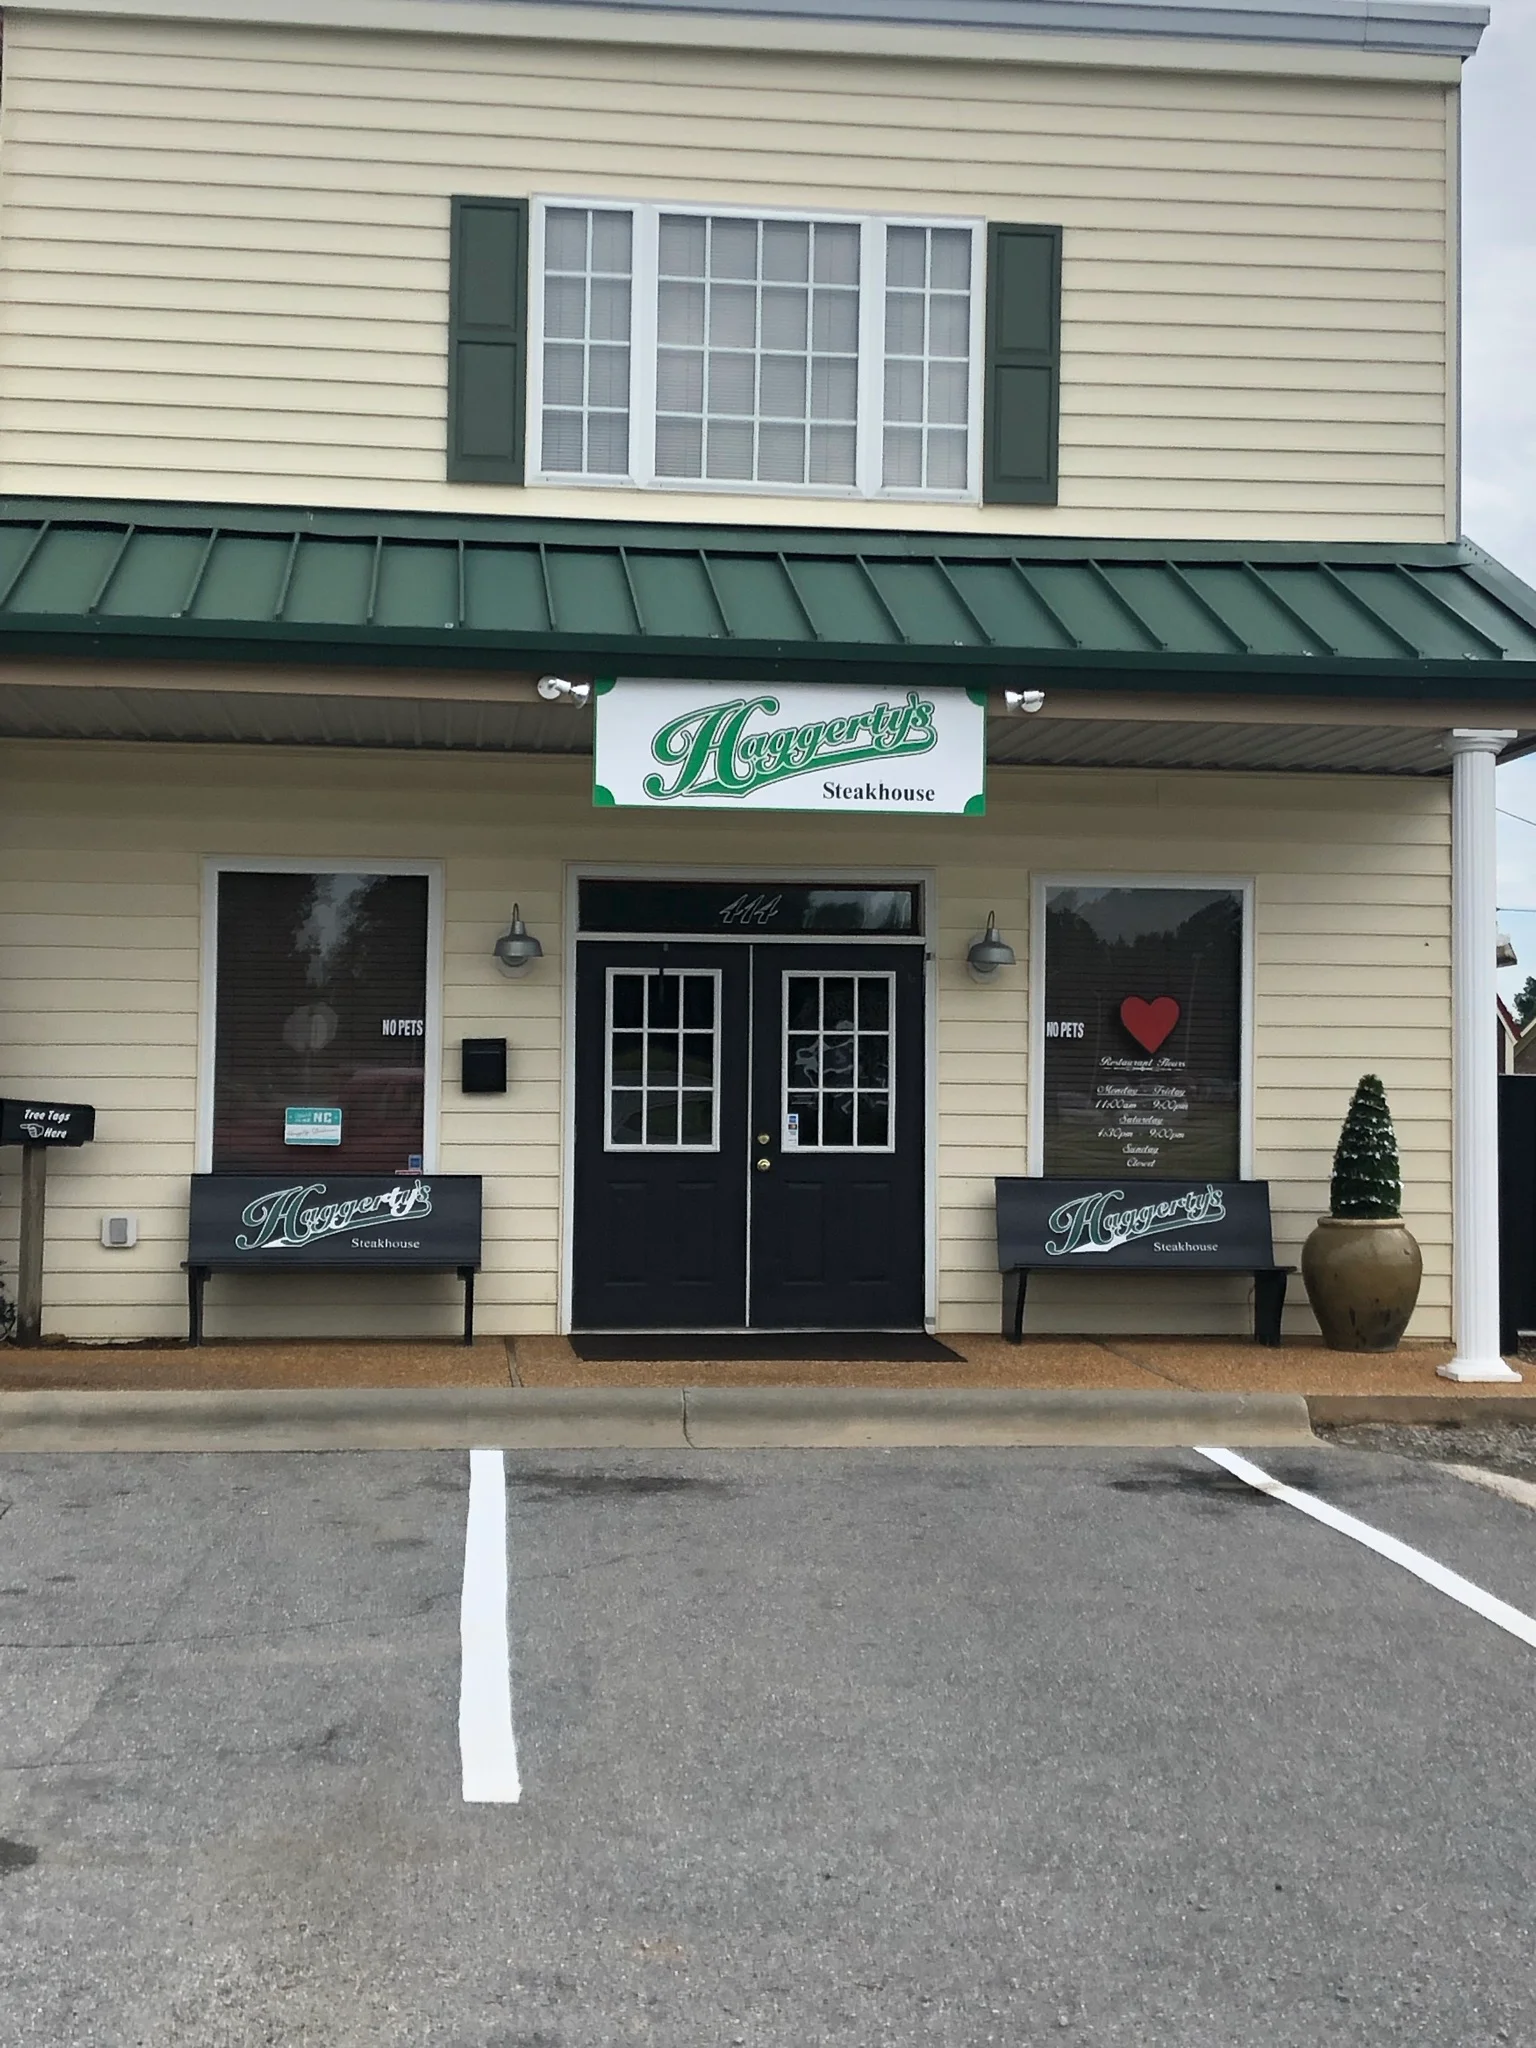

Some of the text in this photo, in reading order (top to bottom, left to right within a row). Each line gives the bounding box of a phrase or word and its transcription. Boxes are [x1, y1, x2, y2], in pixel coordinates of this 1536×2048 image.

[643, 691, 937, 800] Haggerty's
[823, 782, 936, 802] Steakhouse
[382, 1019, 423, 1036] NO PETS
[1047, 1022, 1085, 1038] NO PETS
[1099, 1056, 1153, 1067] Restaurant
[1096, 1085, 1138, 1096] Monday
[1153, 1085, 1186, 1097] Friday
[1153, 1099, 1188, 1112] 9:00pm
[24, 1109, 71, 1124] Tree Tags
[313, 1112, 332, 1123] NC
[1119, 1113, 1163, 1126] Saturday
[44, 1127, 67, 1139] Here
[1149, 1128, 1185, 1140] 9:00pm
[1122, 1143, 1159, 1155] Sunday
[1126, 1157, 1156, 1167] Closed
[235, 1179, 432, 1250] Haggerty's
[1045, 1184, 1226, 1255] Haggerty's
[351, 1238, 420, 1249] Steakhouse
[1154, 1242, 1218, 1252] Steakhouse
